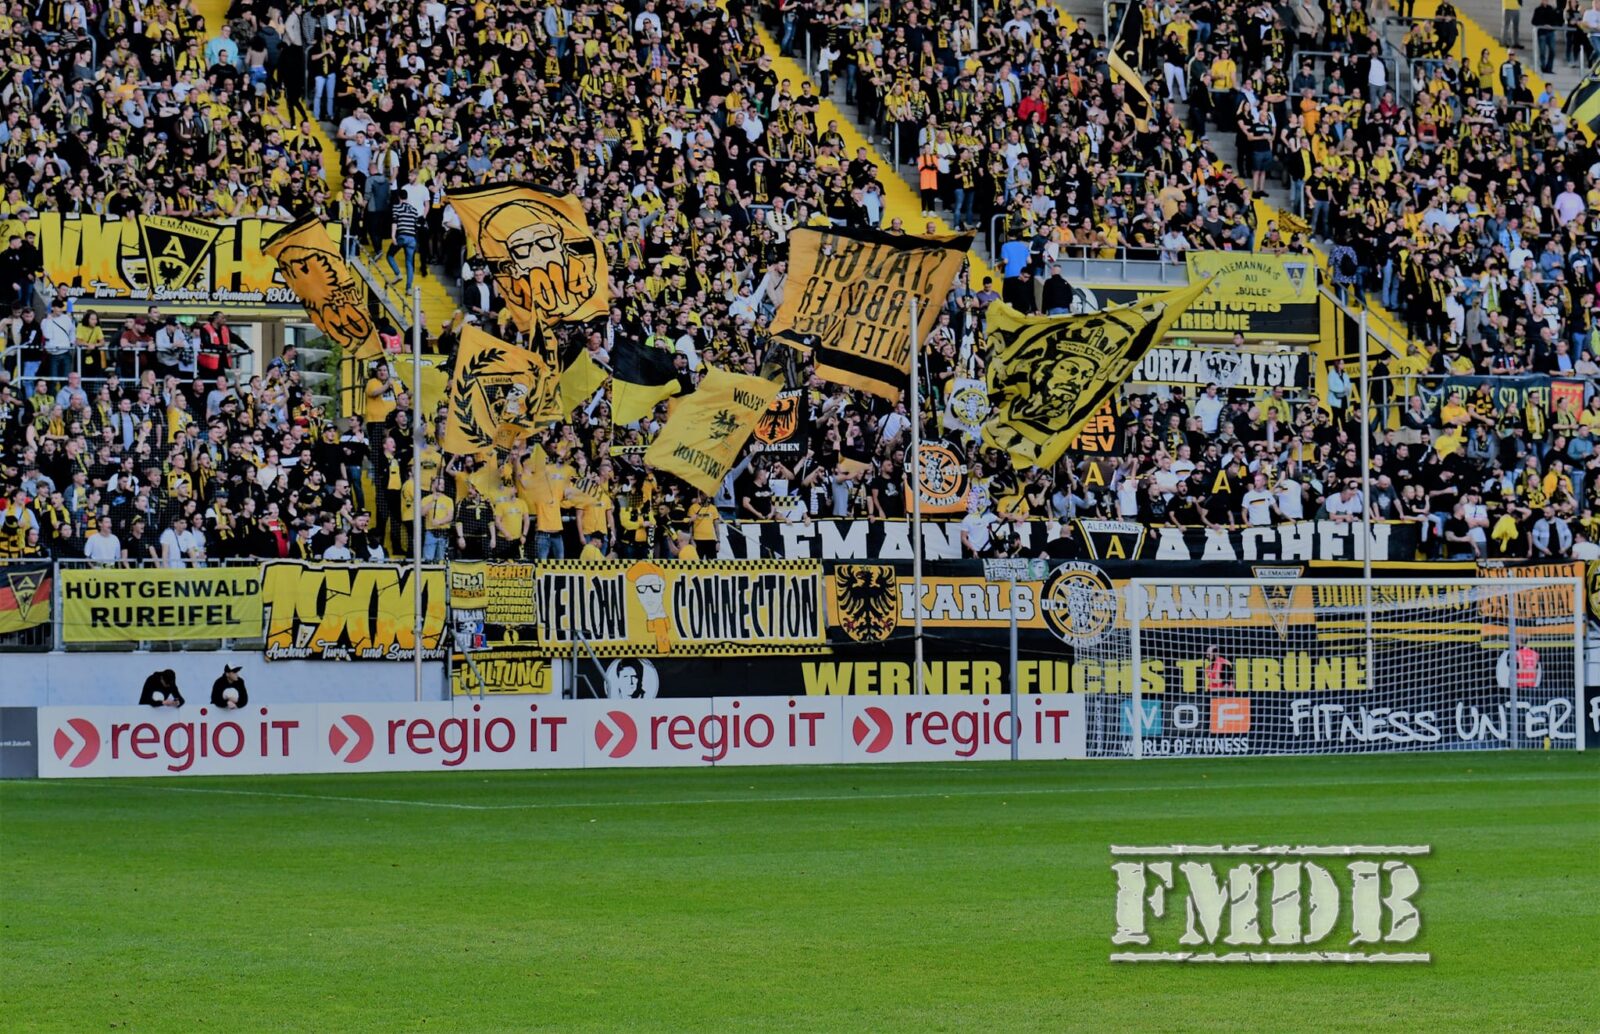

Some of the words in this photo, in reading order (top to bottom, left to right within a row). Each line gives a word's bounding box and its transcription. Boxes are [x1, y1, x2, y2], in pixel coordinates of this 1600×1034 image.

[144, 217, 211, 239] ALEMANNIA
[162, 235, 185, 259] A
[1219, 260, 1272, 275] ALEMANNIA
[130, 286, 149, 299] und
[1238, 352, 1299, 387] ATSV
[765, 443, 800, 452] AACHEN
[1084, 461, 1105, 486] A
[1212, 470, 1231, 494] A
[1106, 535, 1127, 560] A
[1155, 519, 1391, 561] AACHEN
[18, 576, 36, 589] A
[65, 578, 260, 599] HÜRTGENWALD
[536, 573, 627, 641] YELLOW
[673, 573, 819, 639] CONNECTION
[900, 583, 1036, 620] KARLS
[91, 604, 241, 628] RUREIFEL
[267, 642, 313, 660] Aachener
[362, 644, 381, 659] und
[461, 659, 545, 691] HALTUNG
[801, 660, 1002, 695] WERNER
[1017, 659, 1165, 694] FUCHS
[1176, 652, 1367, 693] TIBÜNE
[651, 701, 774, 762] regio
[905, 698, 1023, 757] regio
[1289, 698, 1442, 742] FITNESS
[111, 707, 245, 772] regio
[387, 704, 516, 766] regio
[1121, 738, 1171, 755] WRLD
[1174, 738, 1191, 754] OF
[1194, 737, 1249, 754] FITNESS
